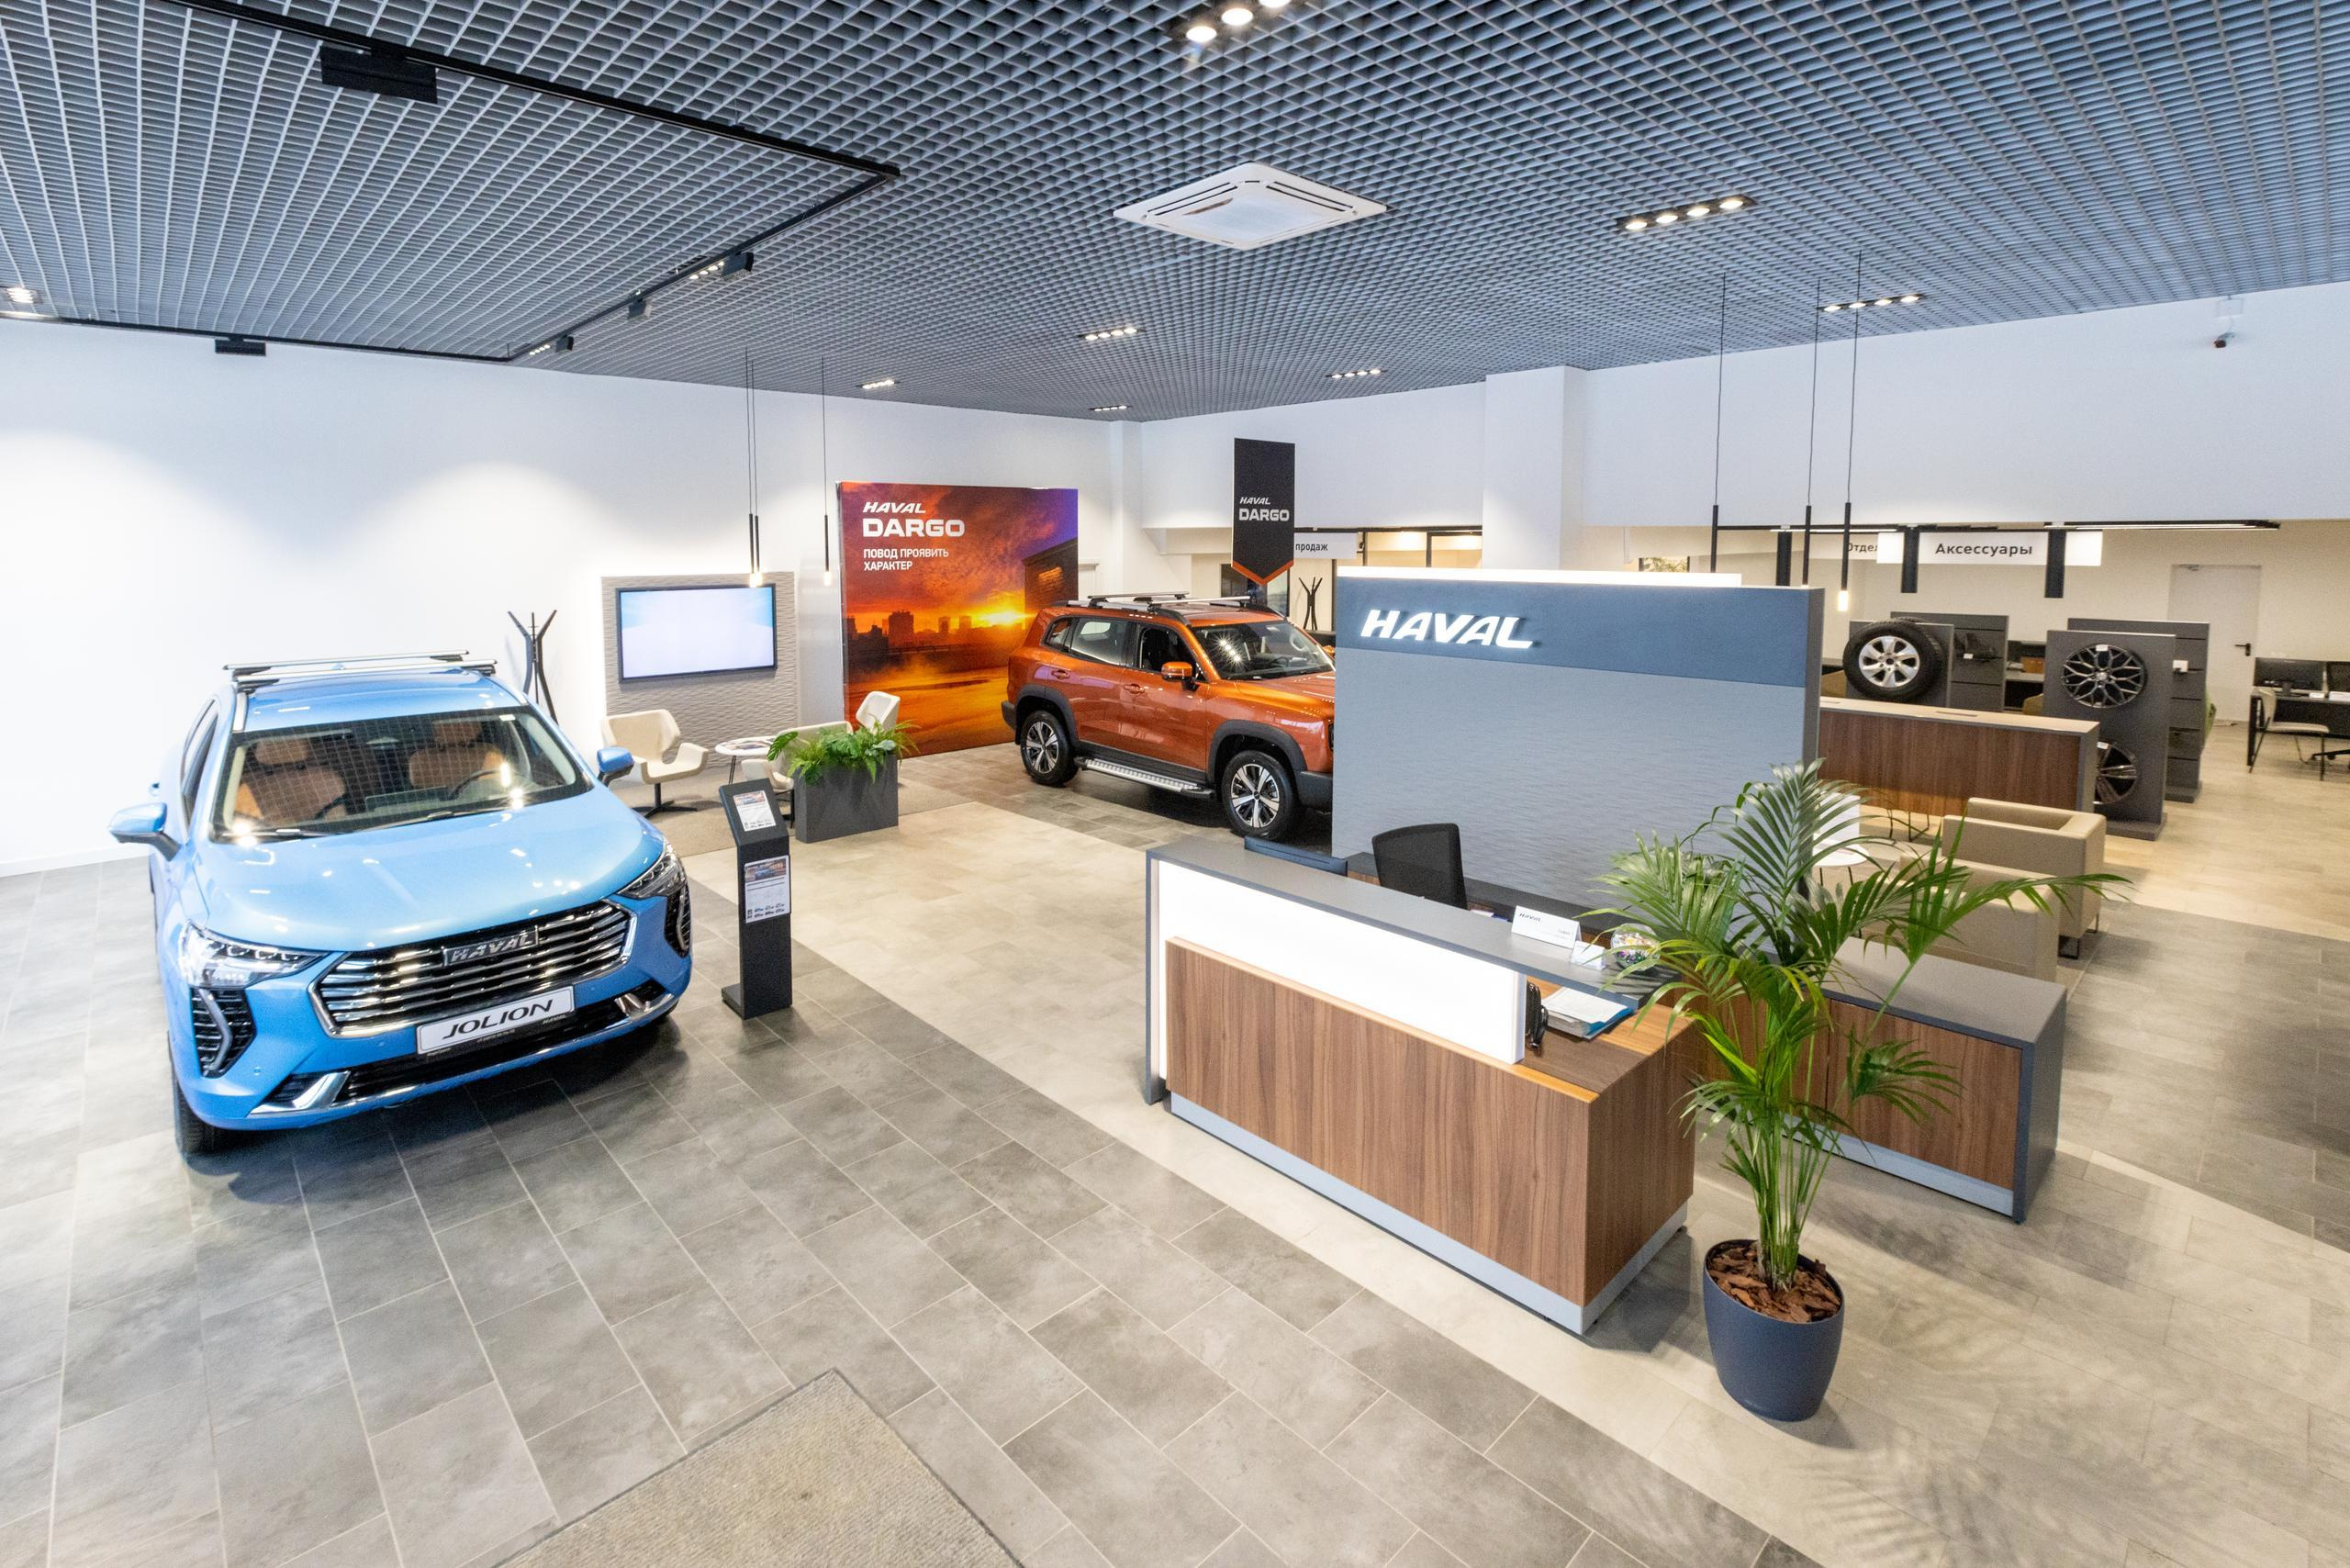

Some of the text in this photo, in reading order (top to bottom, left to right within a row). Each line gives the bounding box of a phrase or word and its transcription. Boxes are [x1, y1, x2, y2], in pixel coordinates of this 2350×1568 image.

[1239, 497, 1270, 505] HAVAL
[863, 502, 925, 513] HAVAL
[1239, 509, 1290, 521] DARGO
[863, 518, 965, 537] DARGO
[864, 548, 949, 559] ПОВОД ПРОЯВИТЬ
[1295, 543, 1328, 553] продаж
[1935, 543, 2033, 557] Аксессуары
[864, 561, 912, 571] ХАРАКТЕР
[1360, 609, 1534, 649] HAVAL
[451, 930, 533, 962] HAVAL
[442, 999, 553, 1039] JOLION
